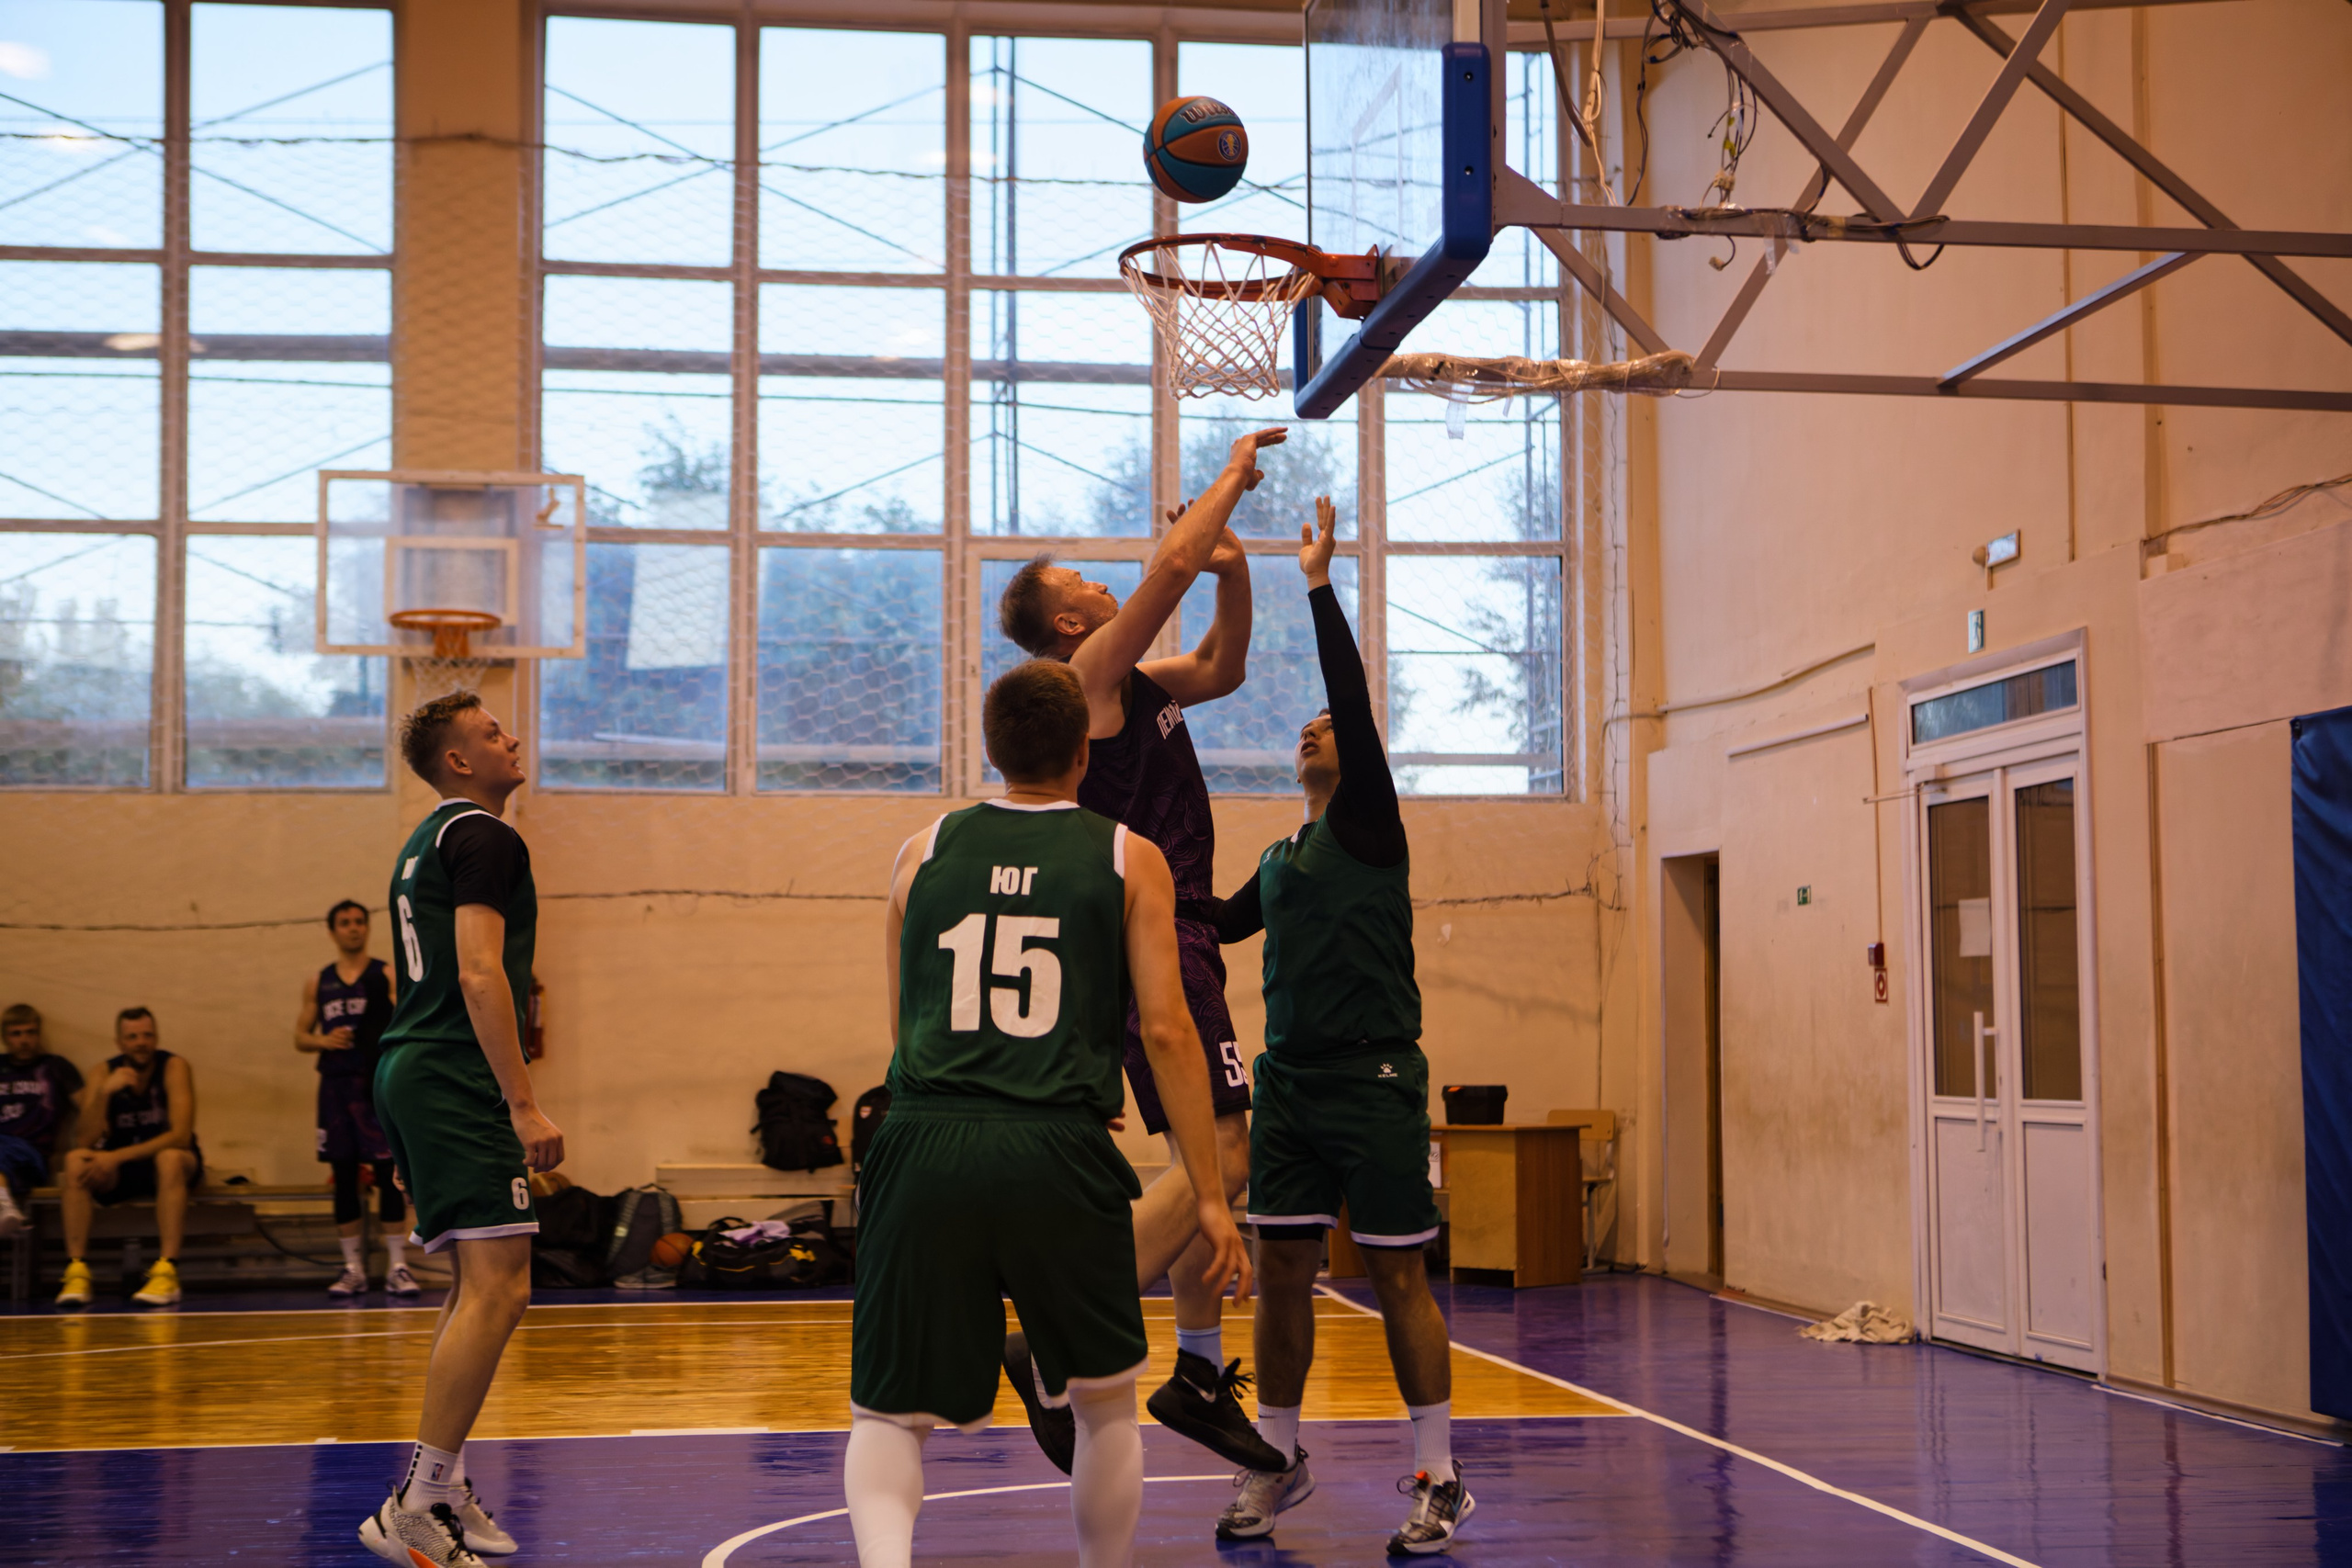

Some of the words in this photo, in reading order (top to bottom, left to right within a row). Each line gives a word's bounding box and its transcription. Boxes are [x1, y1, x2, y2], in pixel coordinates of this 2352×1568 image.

[989, 866, 1038, 896] ЮГ
[397, 894, 424, 983] 6
[938, 913, 1062, 1038] 15
[511, 1177, 530, 1210] 6
